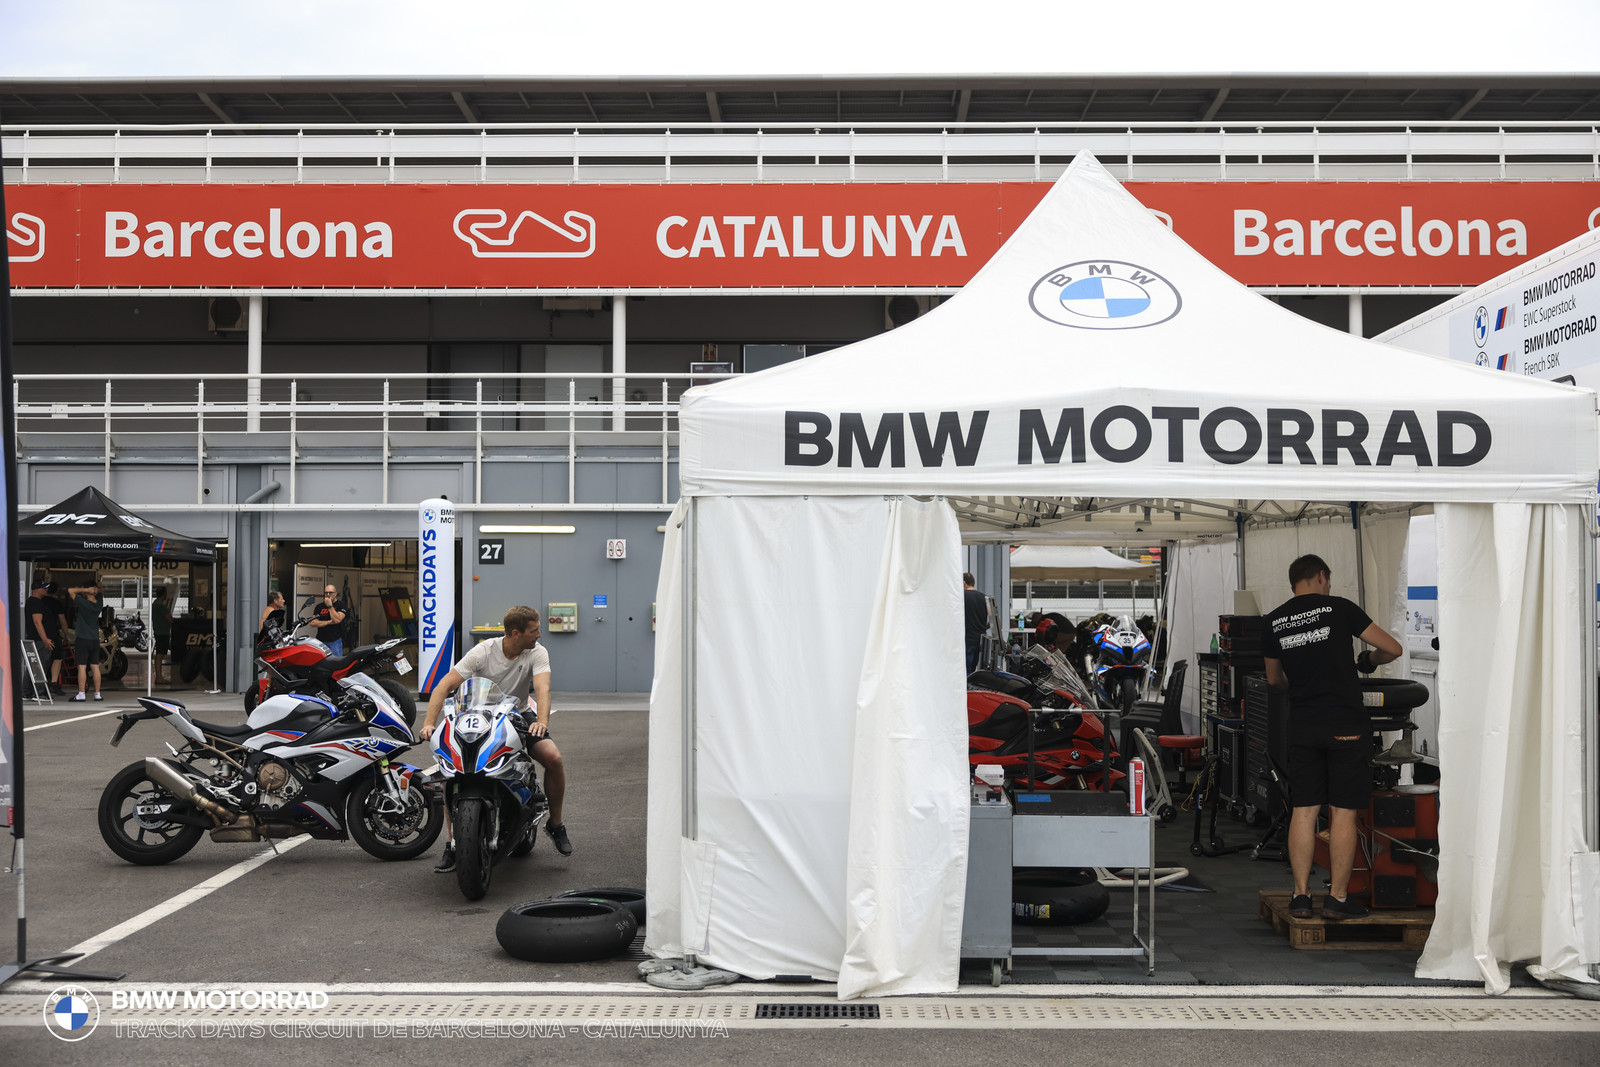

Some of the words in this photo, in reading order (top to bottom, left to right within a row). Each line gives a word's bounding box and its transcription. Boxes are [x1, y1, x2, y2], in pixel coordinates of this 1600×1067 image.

[105, 207, 393, 259] Barcelona
[655, 214, 967, 258] CATALUNYA
[1234, 206, 1528, 257] Barcelona
[1523, 283, 1543, 306] BMW
[1544, 262, 1596, 298] MOTORRAD
[1523, 309, 1538, 328] EWC
[1539, 294, 1577, 322] Superstock
[1524, 333, 1544, 354] BMW
[1545, 315, 1597, 348] MOTORRAD
[1524, 357, 1545, 376] French
[1547, 352, 1560, 369] SBK
[784, 410, 990, 468] BMW
[1017, 405, 1492, 468] MOTORRAD
[35, 513, 107, 525] BMC
[83, 541, 139, 549] bmc-moto.com
[480, 543, 503, 560] 27
[422, 529, 437, 652] TRACKDAYS
[1272, 616, 1289, 627] BMW
[1290, 606, 1333, 622] MOTORRAD
[1272, 614, 1321, 634] MOTORSPORT
[1279, 626, 1331, 647] TECMAS
[465, 717, 480, 729] 12
